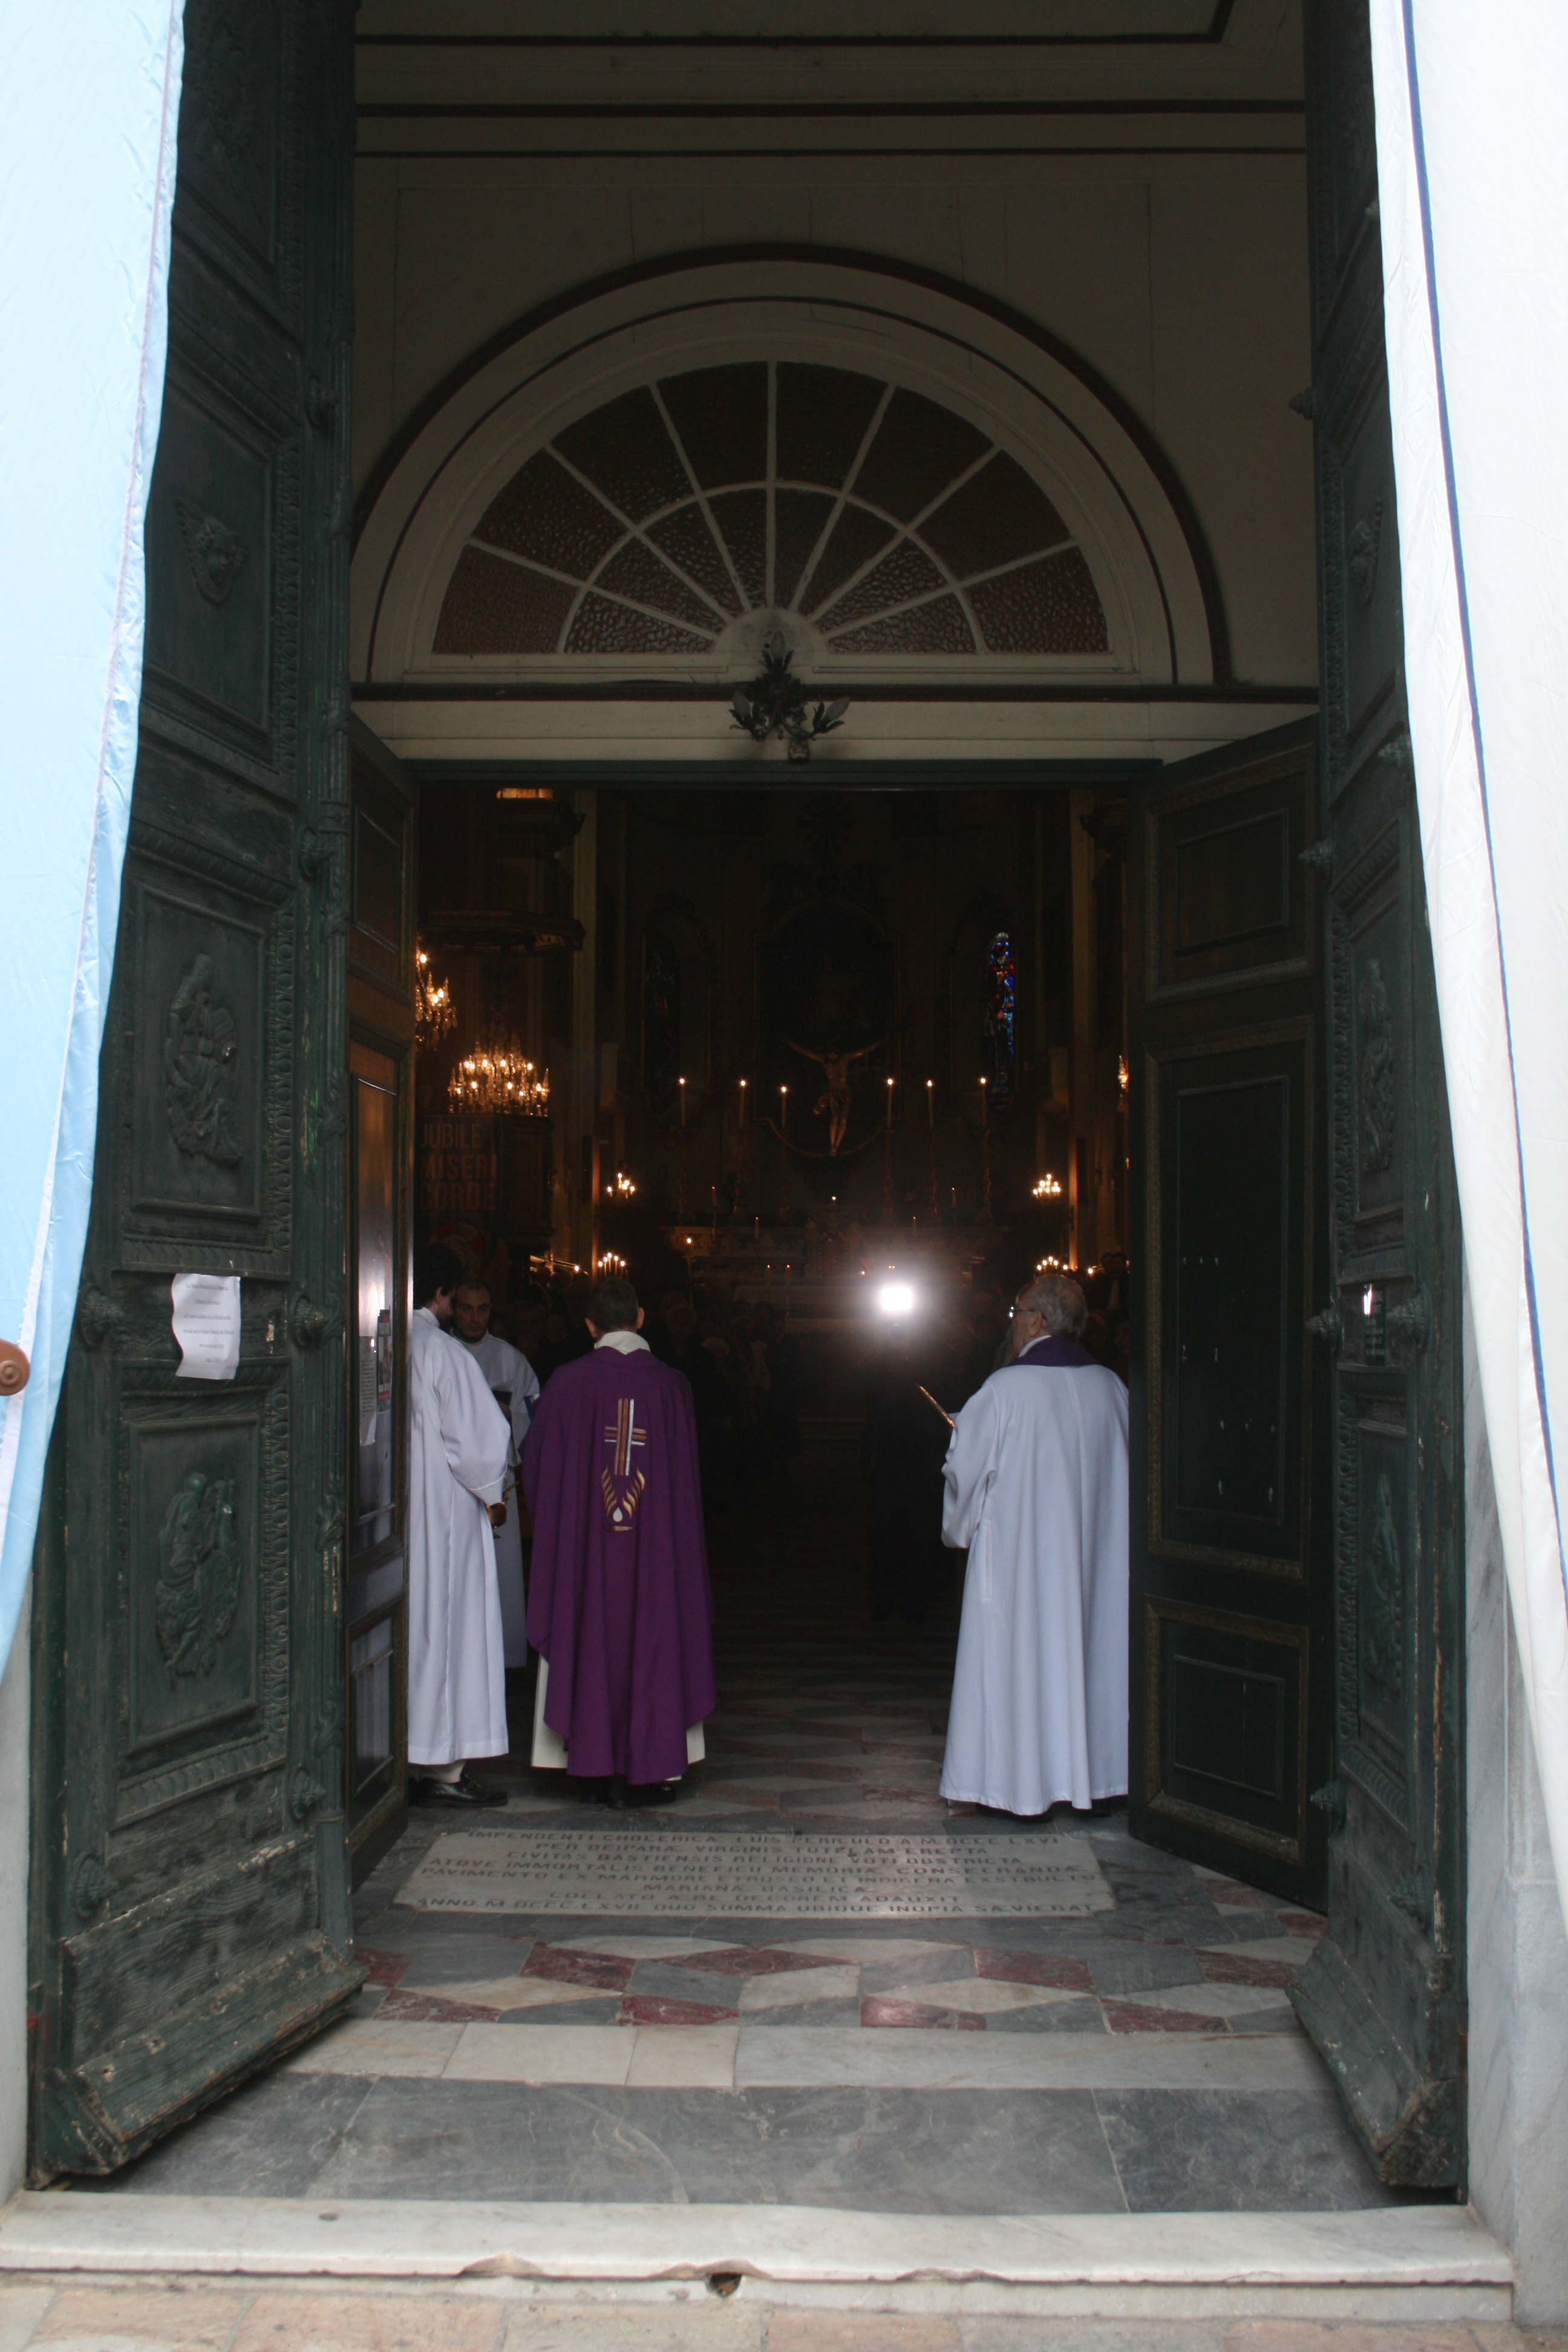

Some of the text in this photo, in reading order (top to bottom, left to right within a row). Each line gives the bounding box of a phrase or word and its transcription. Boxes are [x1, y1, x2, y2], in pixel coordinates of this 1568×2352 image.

[420, 1118, 482, 1148] JUBILÉ
[420, 1151, 497, 1180] MISÉRI
[420, 1182, 495, 1210] CORDE
[468, 1831, 594, 1841] IMPENDENTI
[507, 1851, 587, 1860] CIVITAS
[598, 1854, 722, 1862] BASTIENSIS
[506, 1861, 643, 1872] IMMORTALIS
[421, 1867, 547, 1879] PAVIMENTO
[418, 1898, 475, 1907] ANNO
